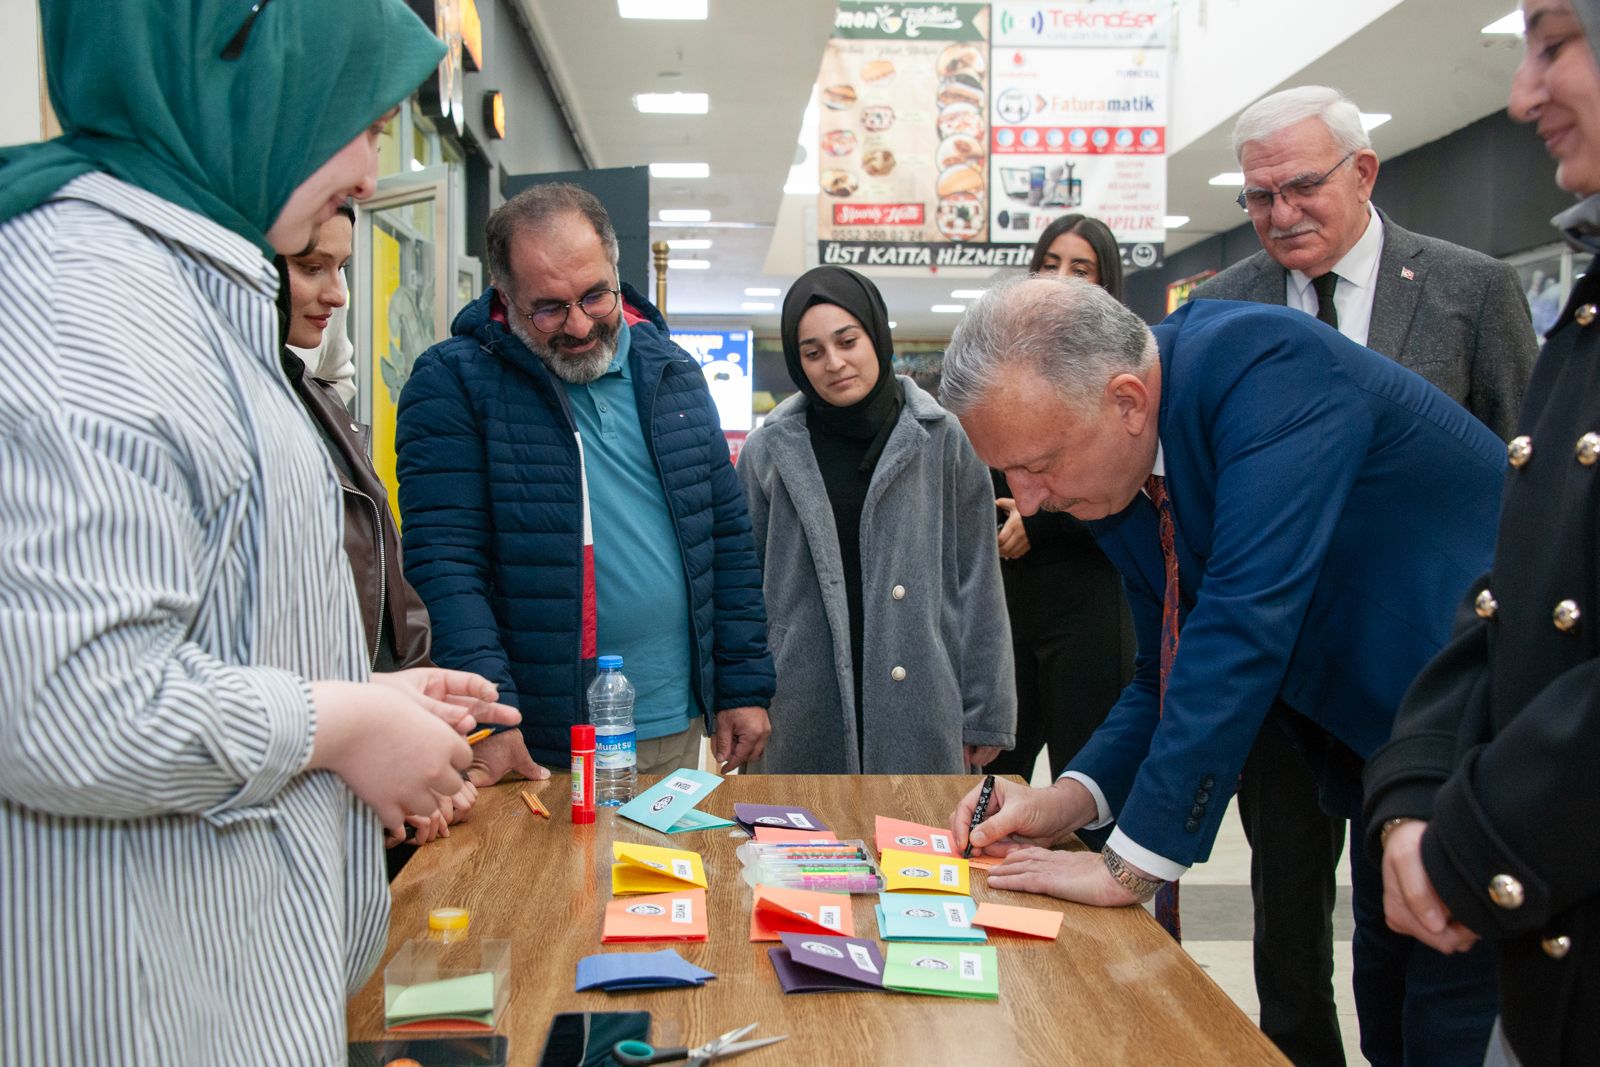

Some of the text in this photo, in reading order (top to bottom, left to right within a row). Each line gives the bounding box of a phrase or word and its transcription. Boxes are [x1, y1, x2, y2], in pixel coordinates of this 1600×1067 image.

[1052, 96, 1154, 112] Faturamatik
[824, 242, 864, 264] ÜST
[867, 247, 931, 264] KATTA
[595, 742, 621, 751] Murat
